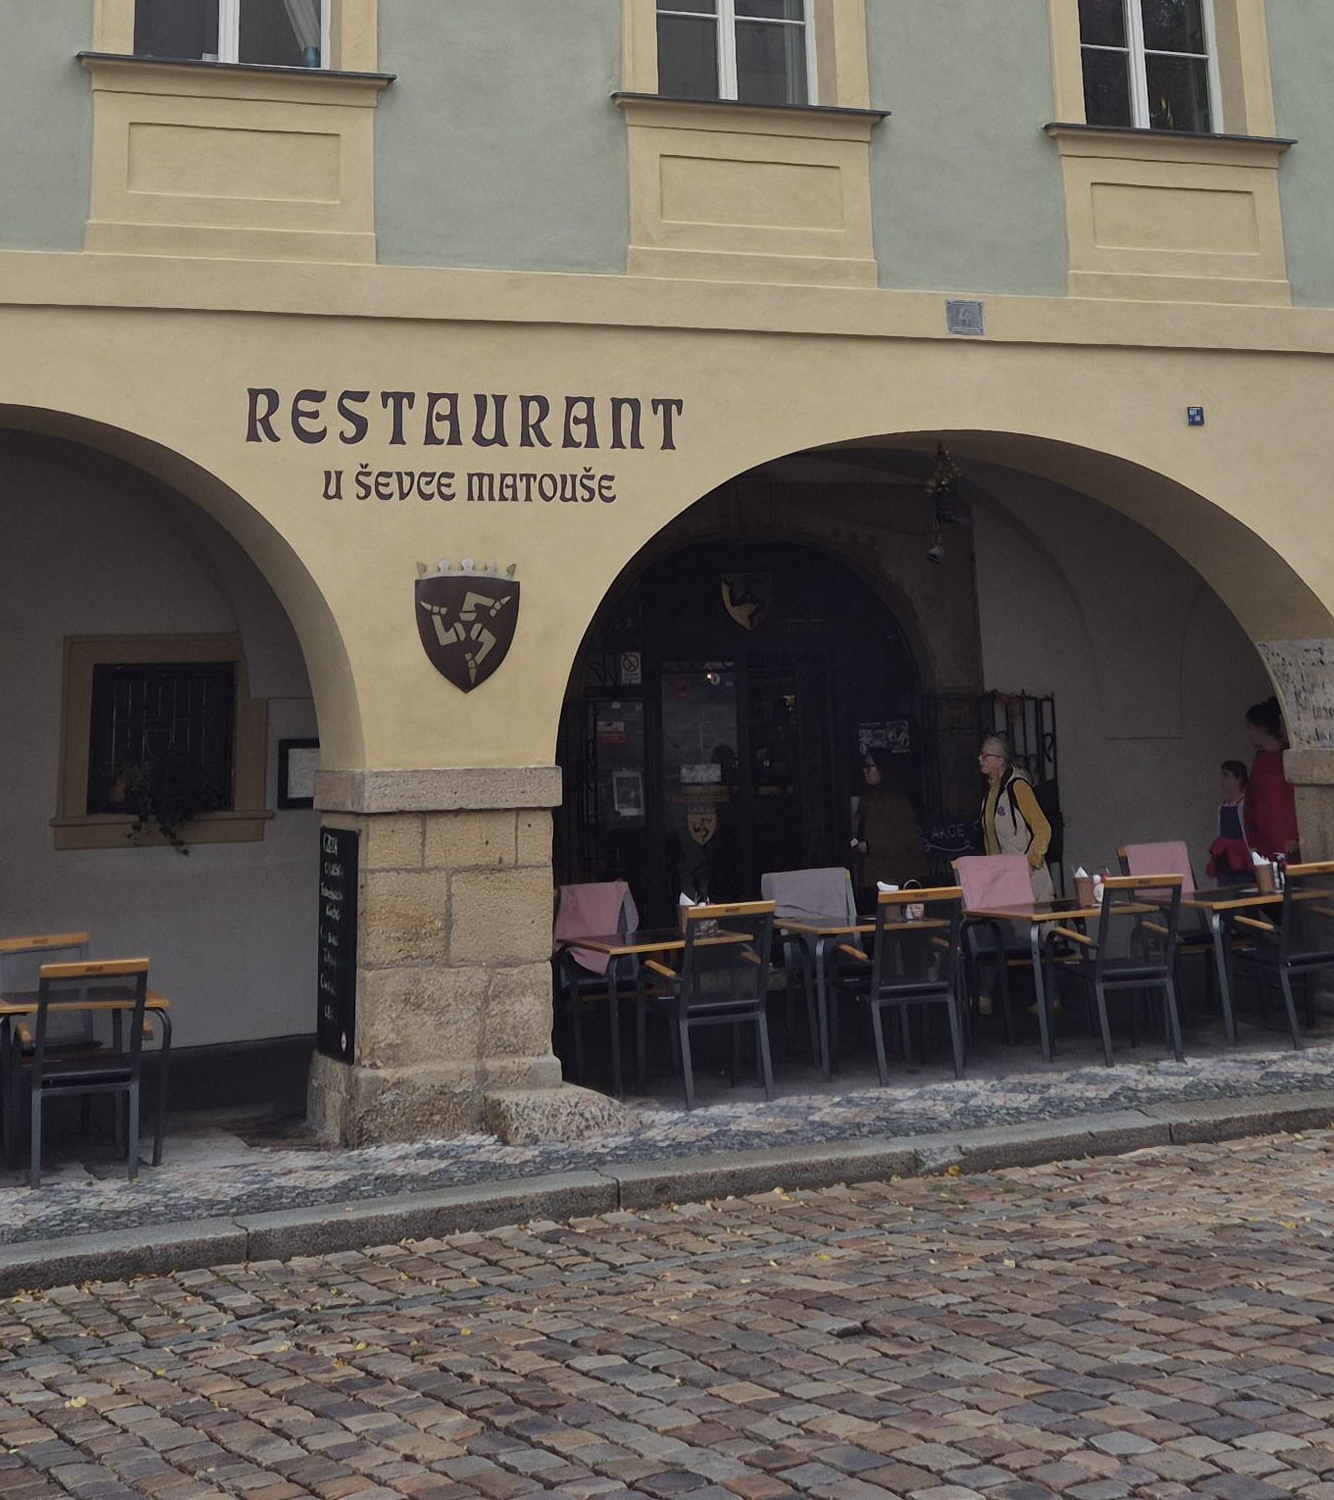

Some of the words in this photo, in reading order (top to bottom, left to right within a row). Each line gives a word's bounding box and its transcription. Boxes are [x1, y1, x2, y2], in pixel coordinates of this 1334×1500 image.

[245, 387, 684, 451] RESTAURANT
[322, 469, 343, 501] U
[354, 463, 456, 501] ŠEVCE
[466, 466, 617, 504] MATOUŠE
